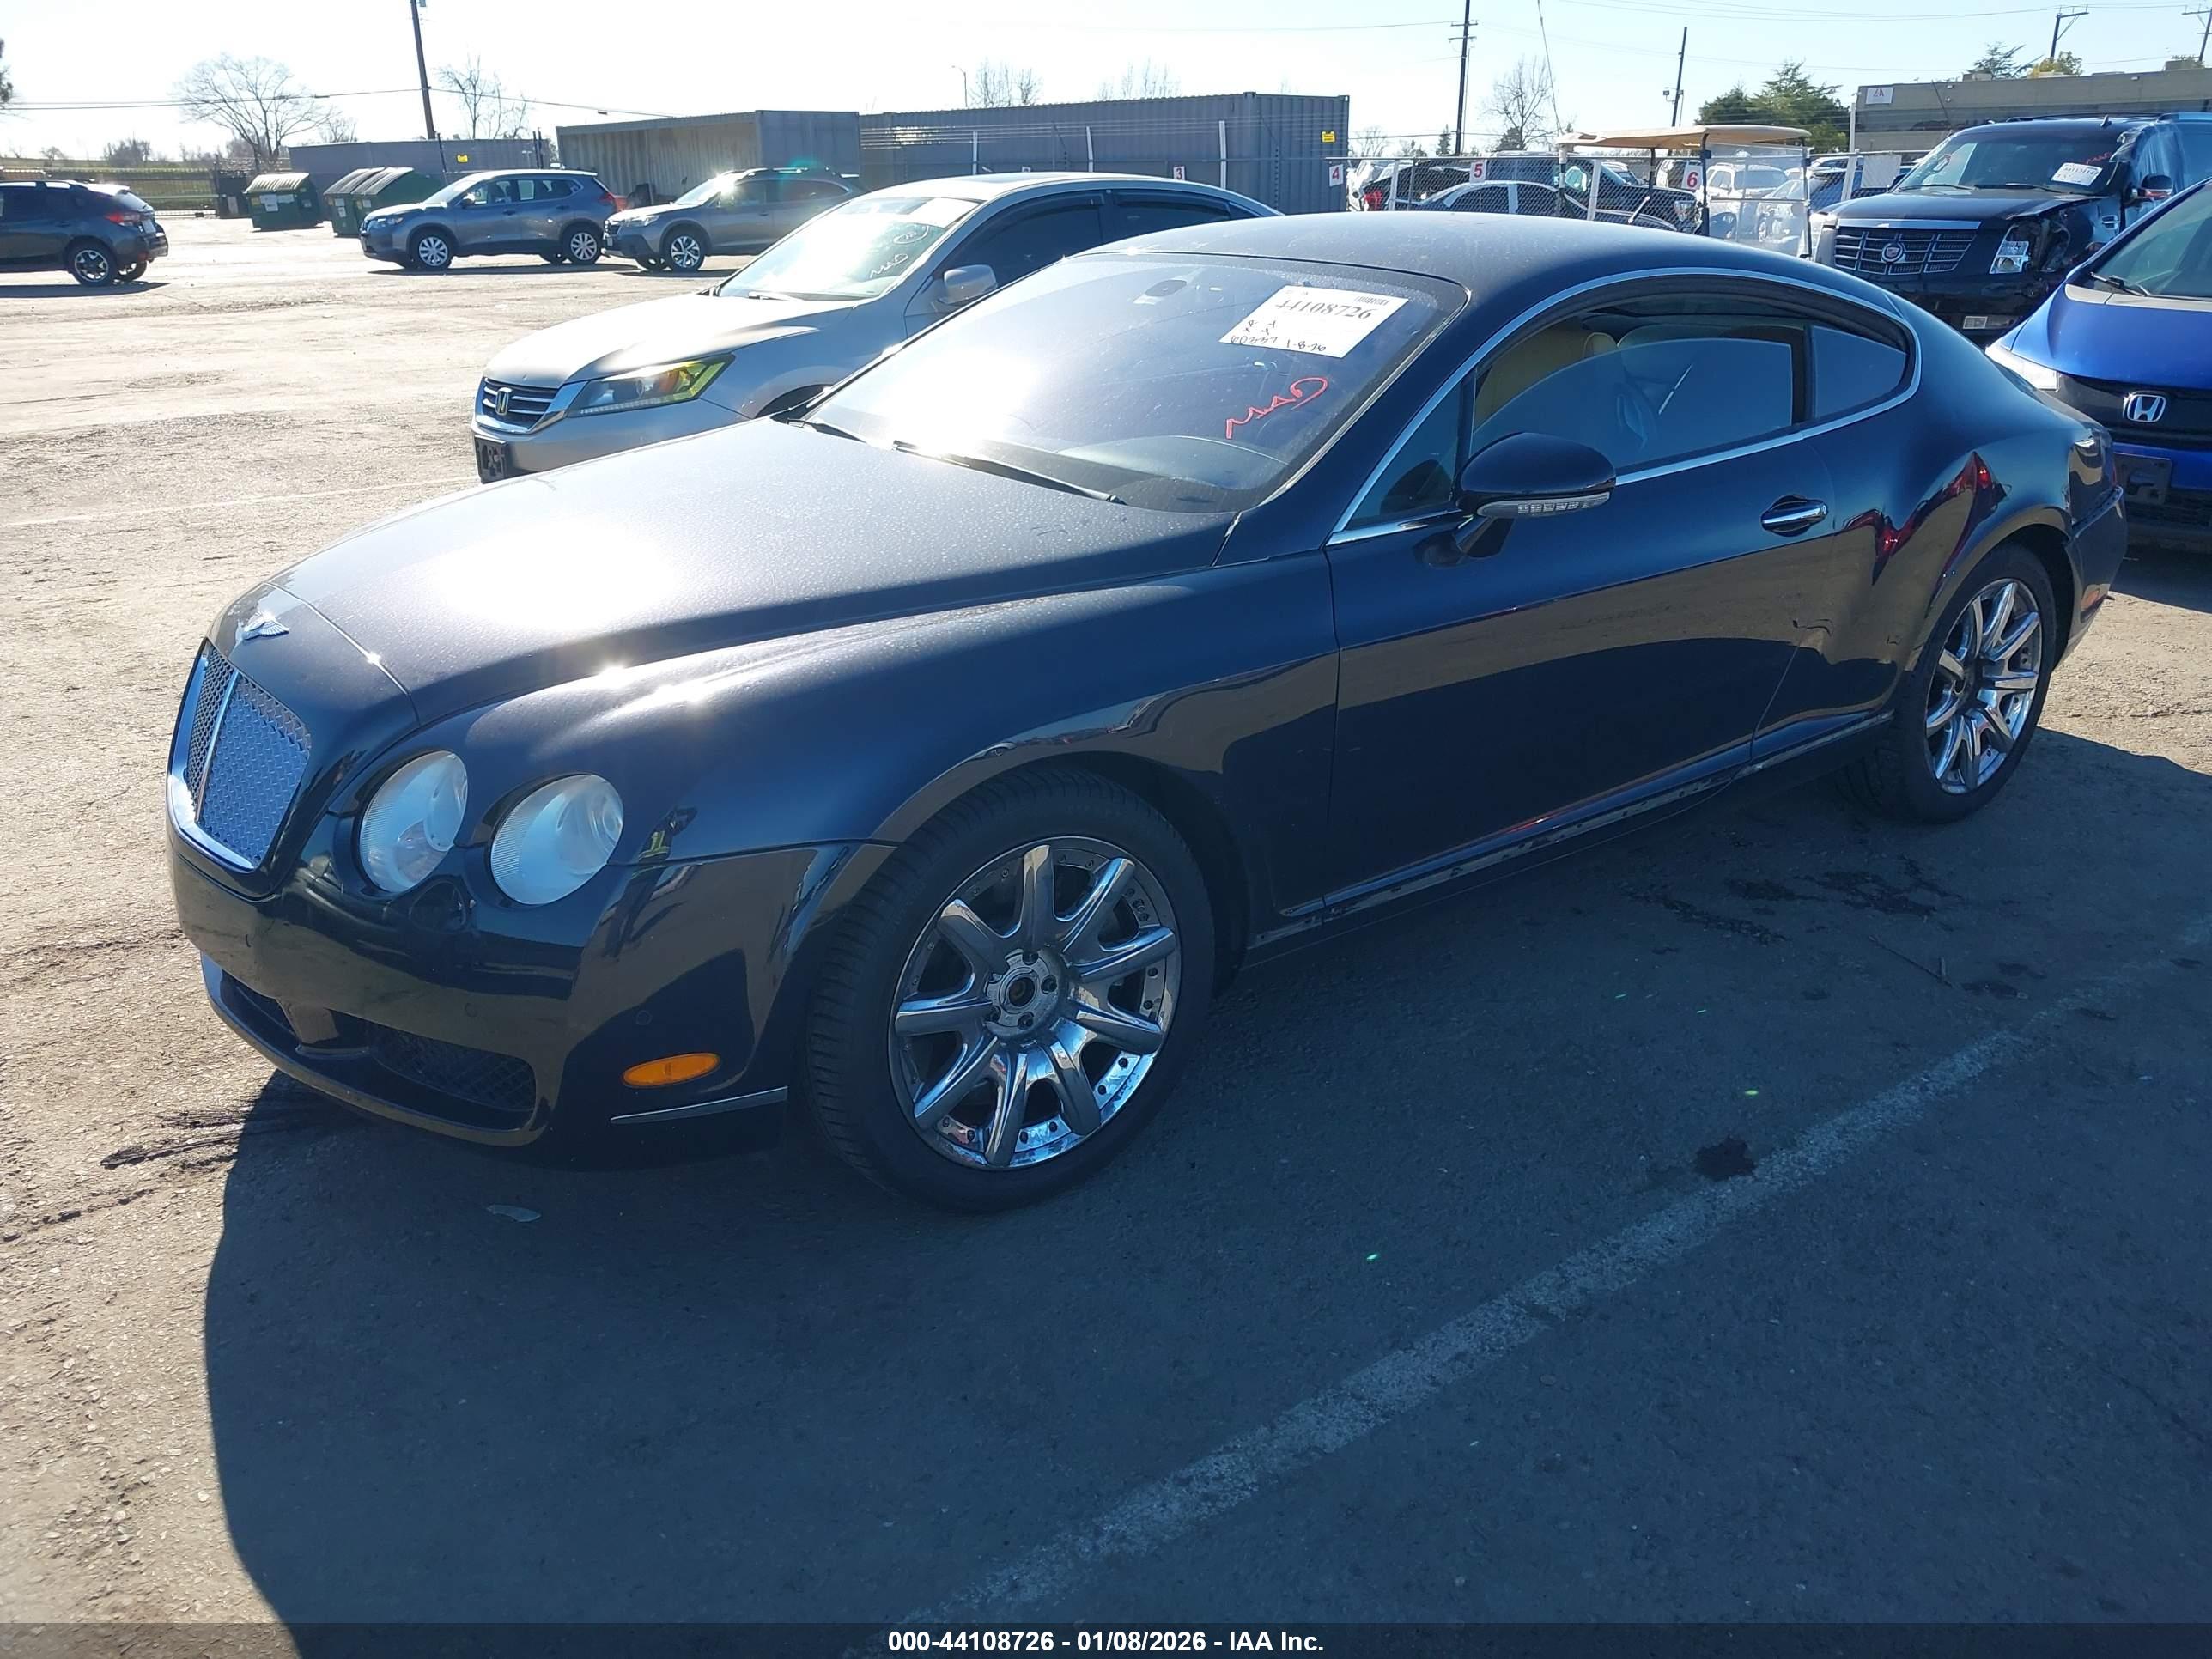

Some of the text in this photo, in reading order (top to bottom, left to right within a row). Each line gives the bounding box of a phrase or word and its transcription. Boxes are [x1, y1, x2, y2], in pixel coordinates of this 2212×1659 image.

[1176, 167, 1182, 180] 3
[1332, 167, 1340, 179] 4
[1474, 163, 1483, 178] 5
[1687, 171, 1698, 188] 6
[1275, 300, 1376, 319] 44108726
